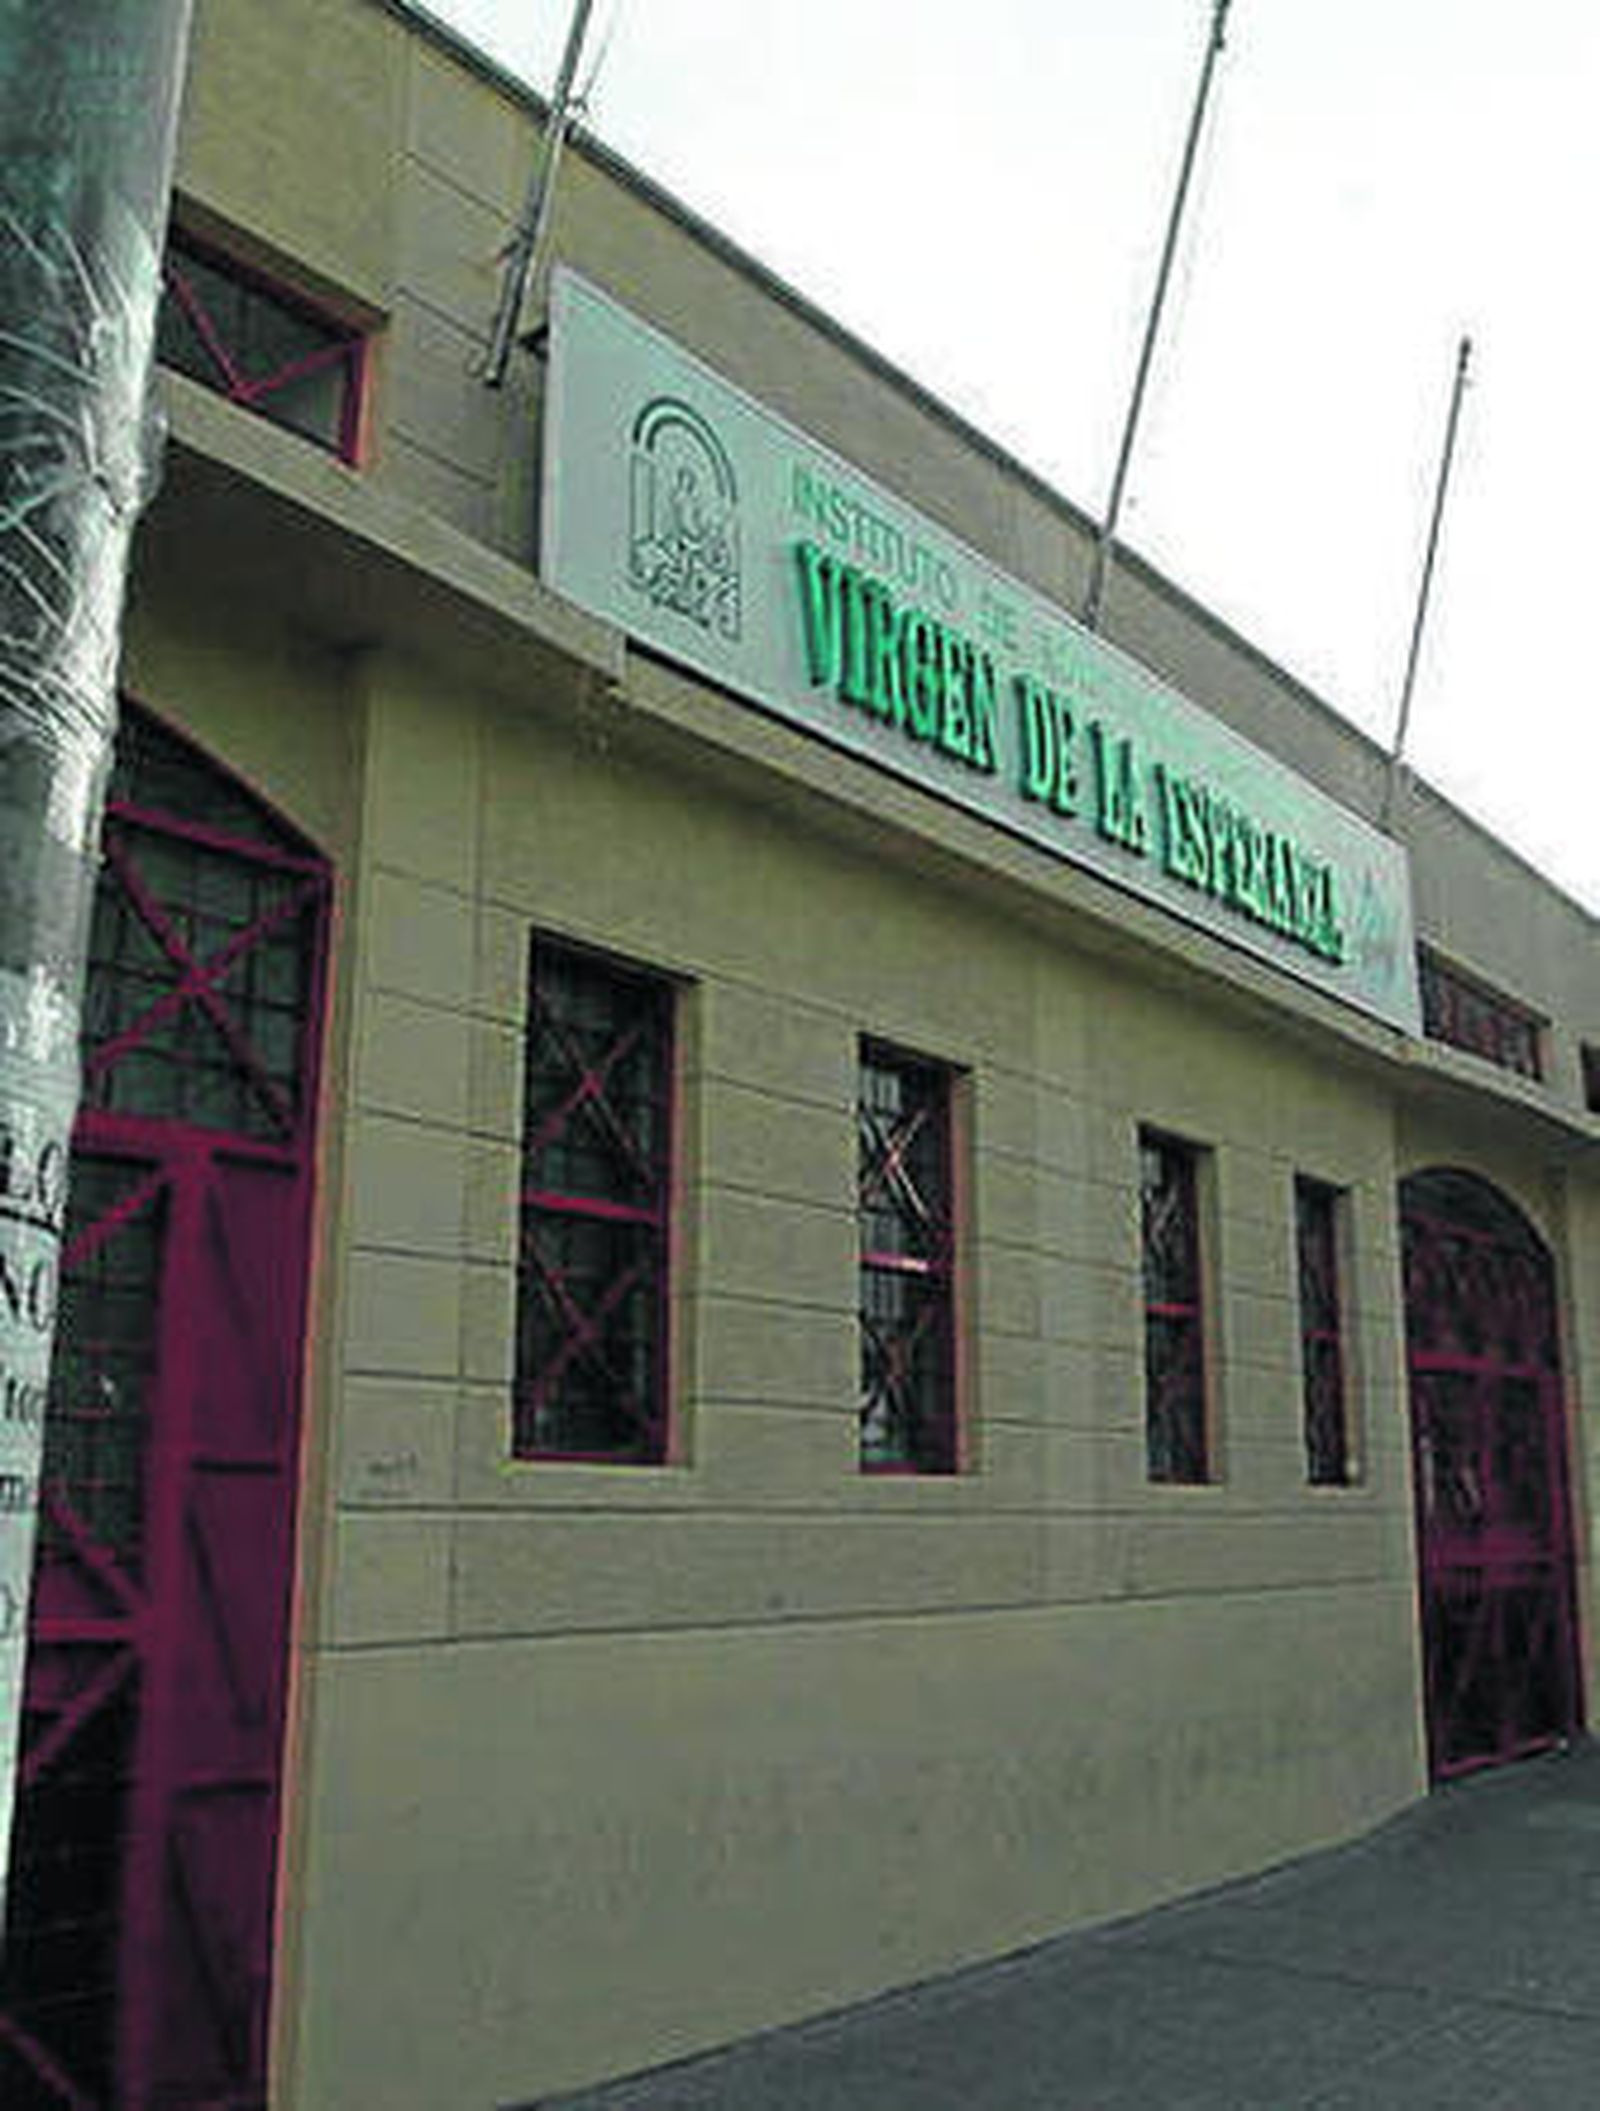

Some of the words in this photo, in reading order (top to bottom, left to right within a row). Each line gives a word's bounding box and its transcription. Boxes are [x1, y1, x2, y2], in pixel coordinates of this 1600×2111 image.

[794, 538, 995, 775] VIRGEN
[1012, 672, 1078, 818] DE
[1088, 720, 1146, 858] LA
[1153, 762, 1344, 966] ESPERANZA
